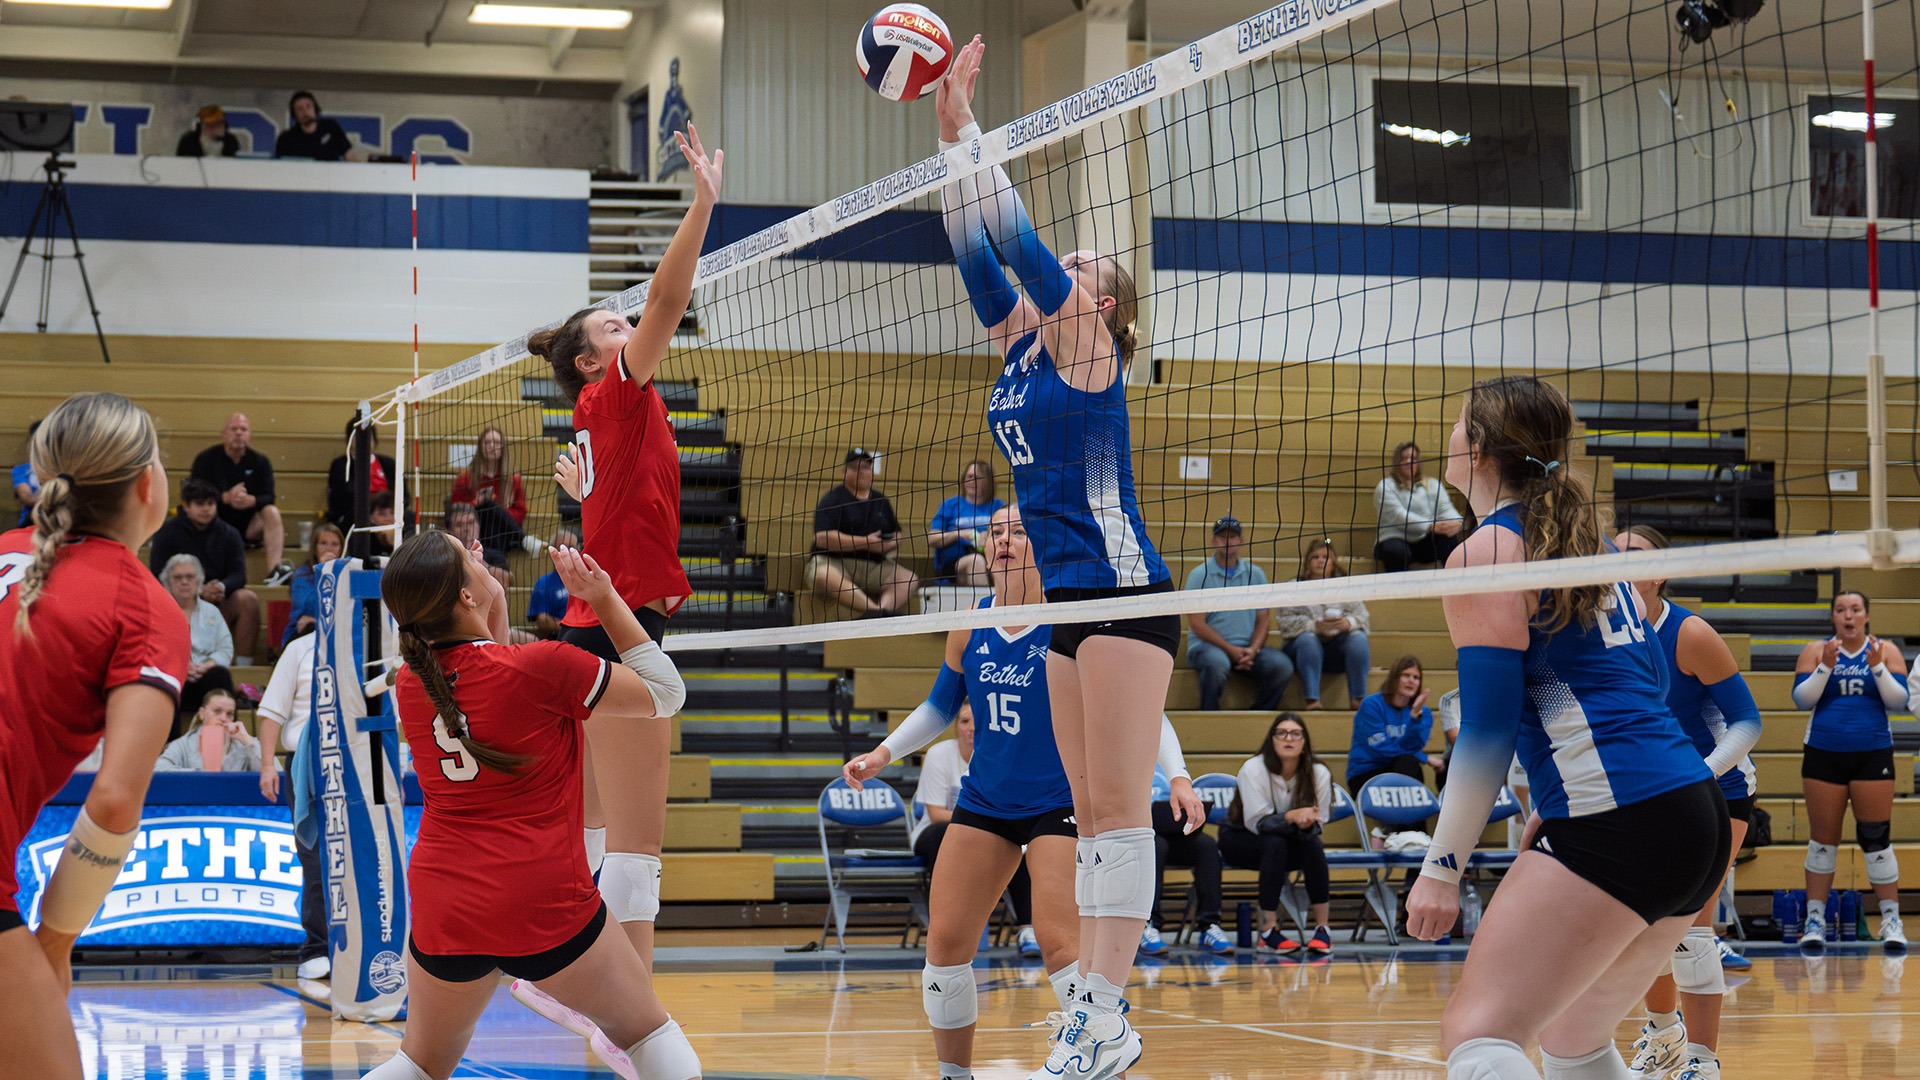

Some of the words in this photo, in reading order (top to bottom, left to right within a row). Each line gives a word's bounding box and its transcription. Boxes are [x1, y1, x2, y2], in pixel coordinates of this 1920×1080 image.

[888, 12, 942, 40] molten
[1238, 0, 1309, 54] BETHEL
[1007, 105, 1060, 151] BETHEL
[1061, 63, 1157, 126] VOLLEYBALL
[834, 185, 876, 223] BETHEL
[875, 152, 948, 205] VOLLEYBALL
[989, 382, 1029, 412] Bethel
[995, 419, 1034, 467] 13
[979, 661, 1035, 688] Bethel
[1833, 663, 1870, 677] Bethel
[1838, 678, 1865, 696] 16
[986, 692, 1022, 736] 15
[316, 666, 348, 923] BETHEL
[828, 788, 896, 810] BETHEL
[1367, 786, 1433, 808] BETHEL
[126, 887, 275, 908] PILOTS
